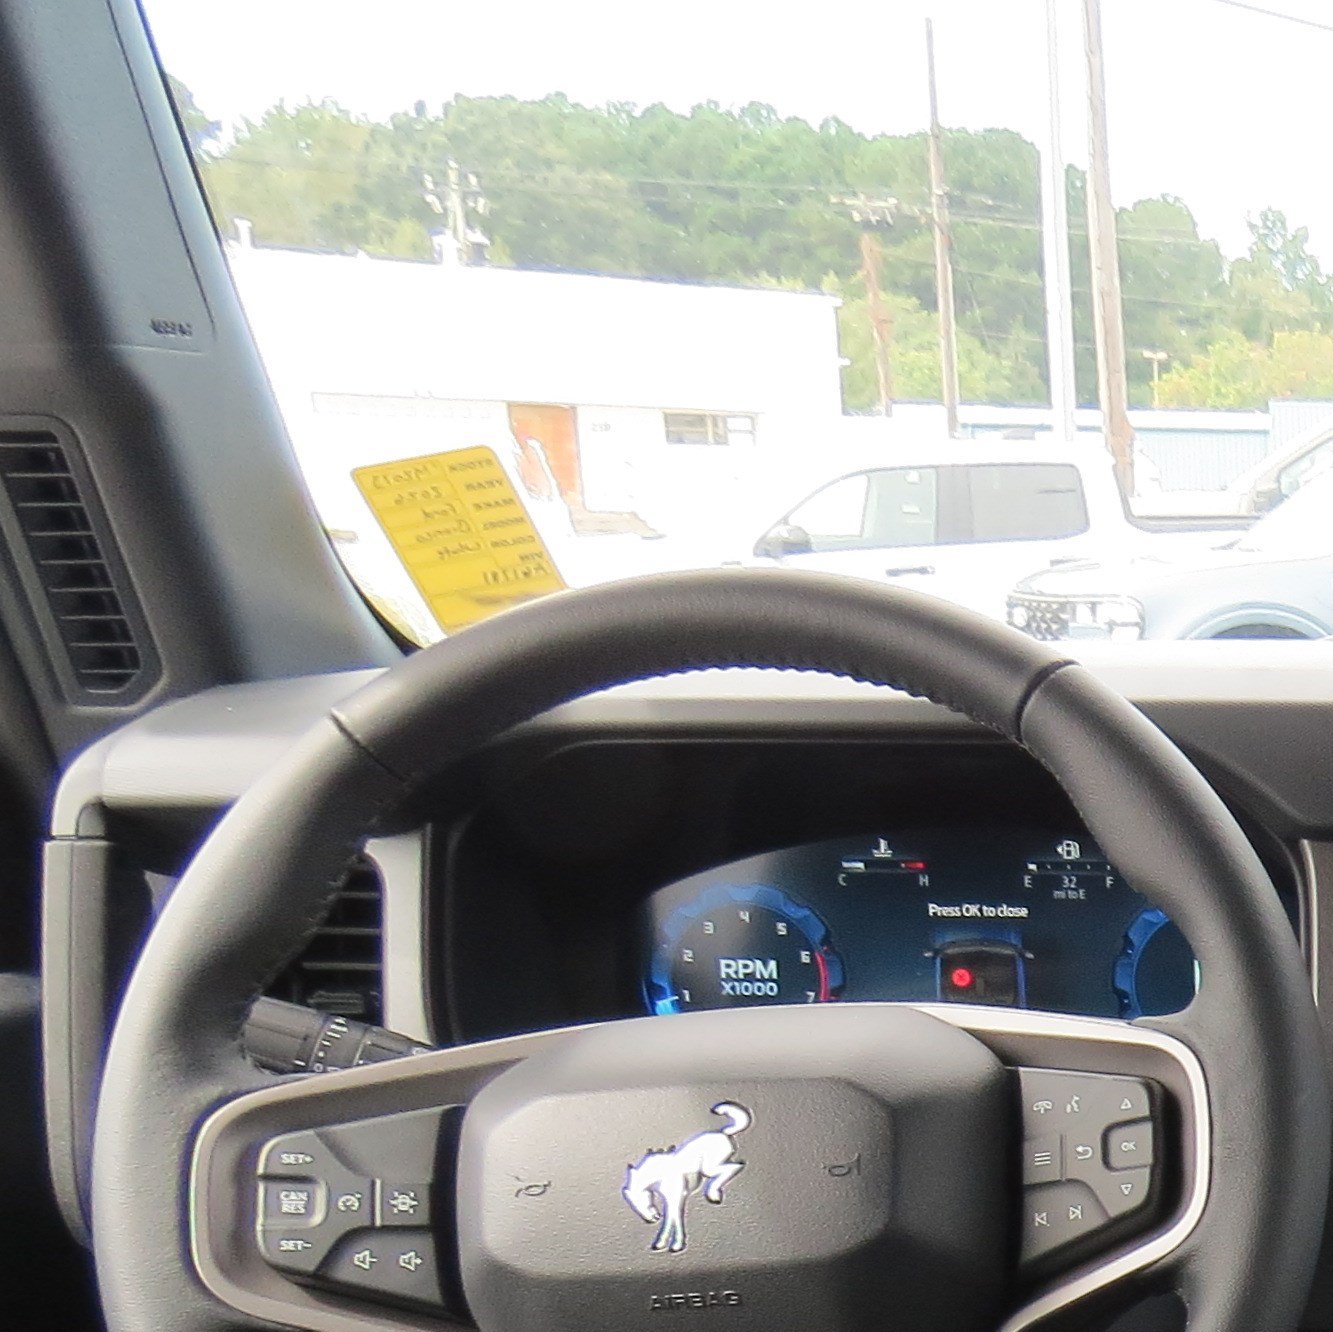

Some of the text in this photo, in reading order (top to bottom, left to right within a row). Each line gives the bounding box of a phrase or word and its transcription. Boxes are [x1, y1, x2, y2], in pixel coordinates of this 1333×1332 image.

[838, 875, 847, 886] C
[919, 875, 930, 886] H
[1024, 876, 1033, 888] E
[1062, 875, 1077, 888] 32
[1105, 876, 1114, 888] F
[928, 903, 1029, 918] Press OK to close
[739, 911, 750, 924] 4
[703, 921, 714, 934] 3
[776, 922, 787, 935] 5
[683, 950, 694, 963] 2
[801, 951, 811, 963] 6
[719, 959, 779, 979] RPM
[721, 982, 779, 996] X1000
[683, 989, 691, 1002] 1
[806, 991, 816, 1003] 7
[1121, 1141, 1136, 1151] OK
[280, 1153, 315, 1164] SET+
[280, 1190, 308, 1201] CAN
[281, 1202, 306, 1213] RES
[648, 1290, 740, 1309] AIRBAG
